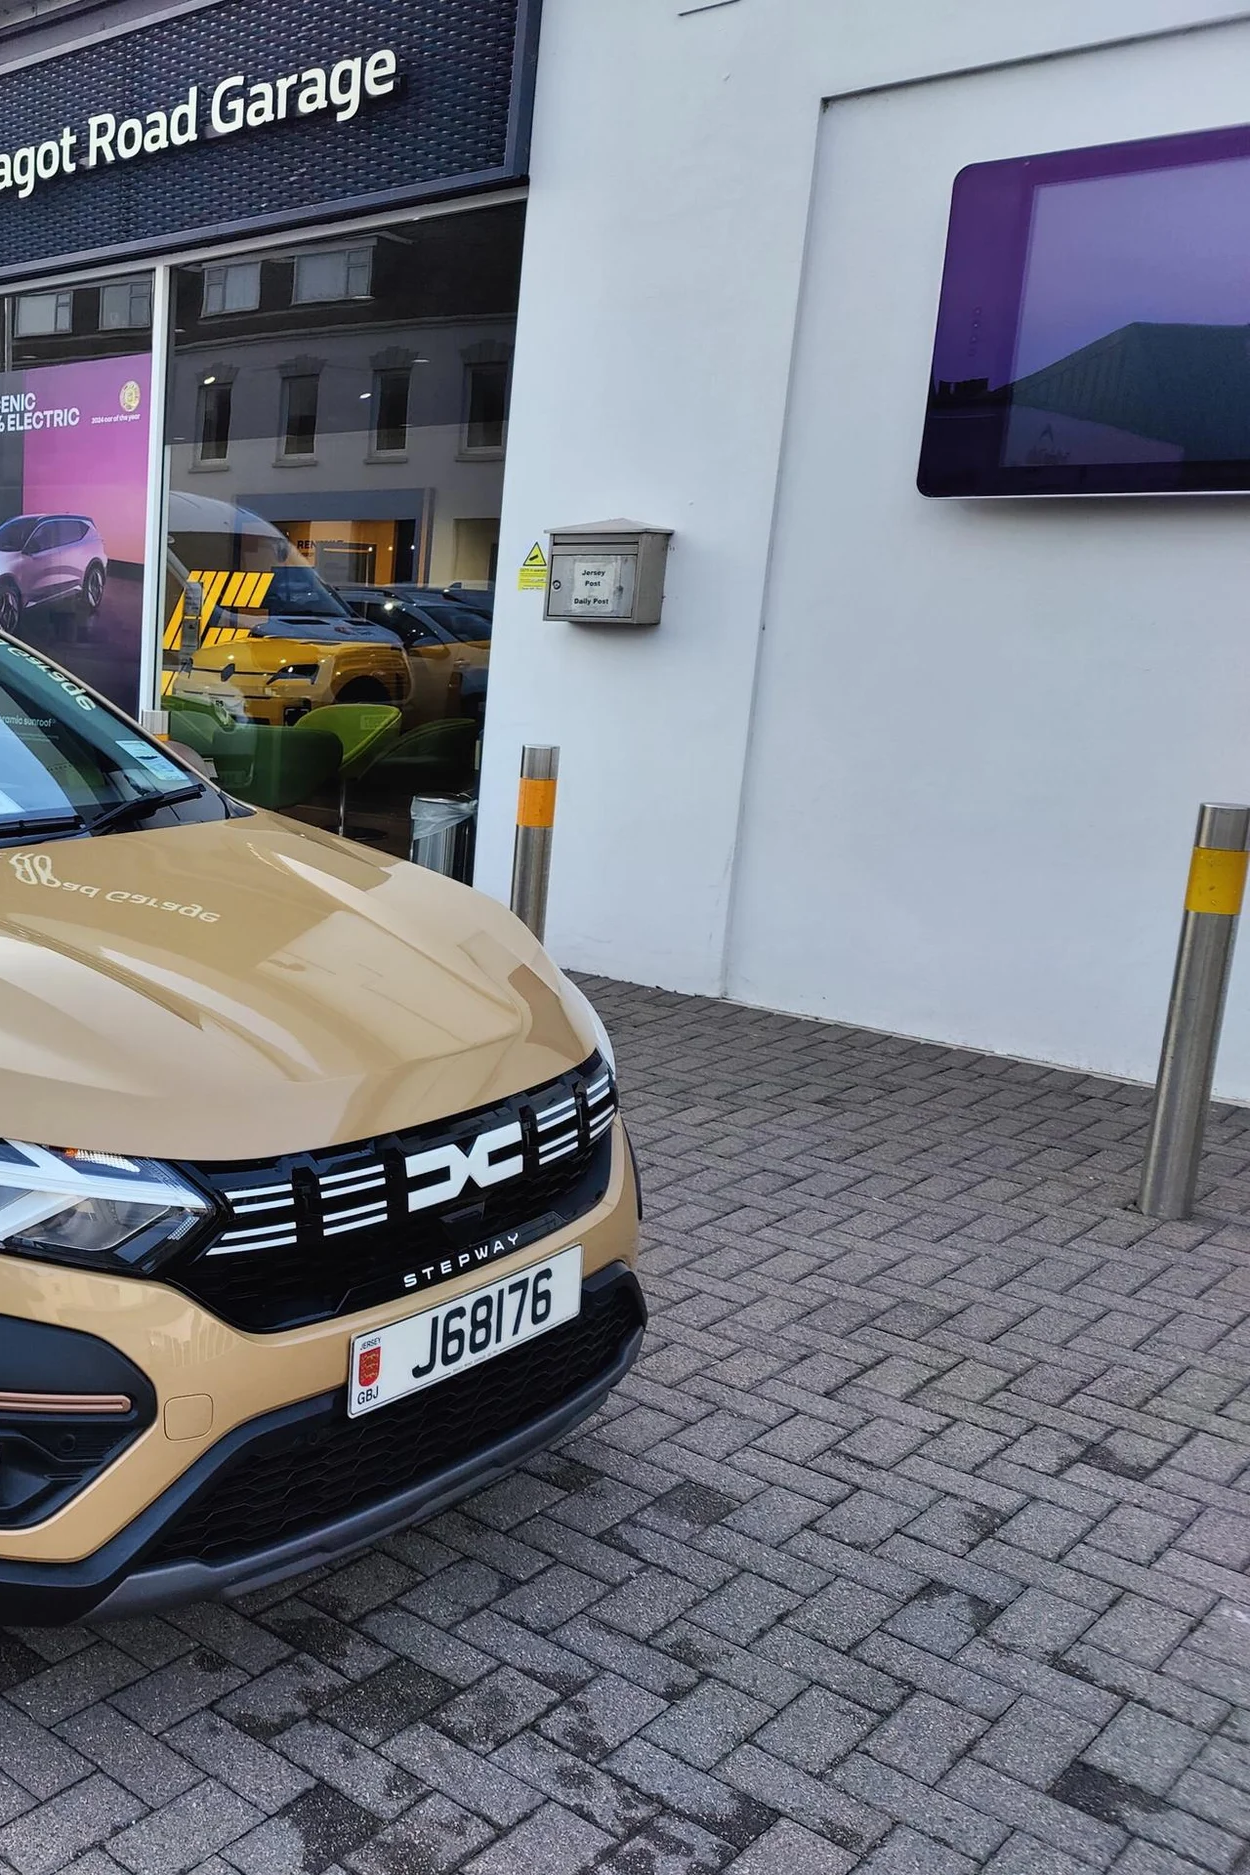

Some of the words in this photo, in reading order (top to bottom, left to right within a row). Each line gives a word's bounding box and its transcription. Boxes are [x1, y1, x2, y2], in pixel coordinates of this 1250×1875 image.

[87, 86, 199, 166] Road
[211, 48, 397, 133] Garage
[7, 407, 81, 432] ELECTRIC
[582, 569, 606, 577] Jersey
[574, 598, 591, 606] Daily
[403, 1232, 520, 1288] STEPWAY
[411, 1267, 553, 1379] J68176
[360, 1337, 382, 1351] JERSEY
[357, 1386, 380, 1405] GBJ
